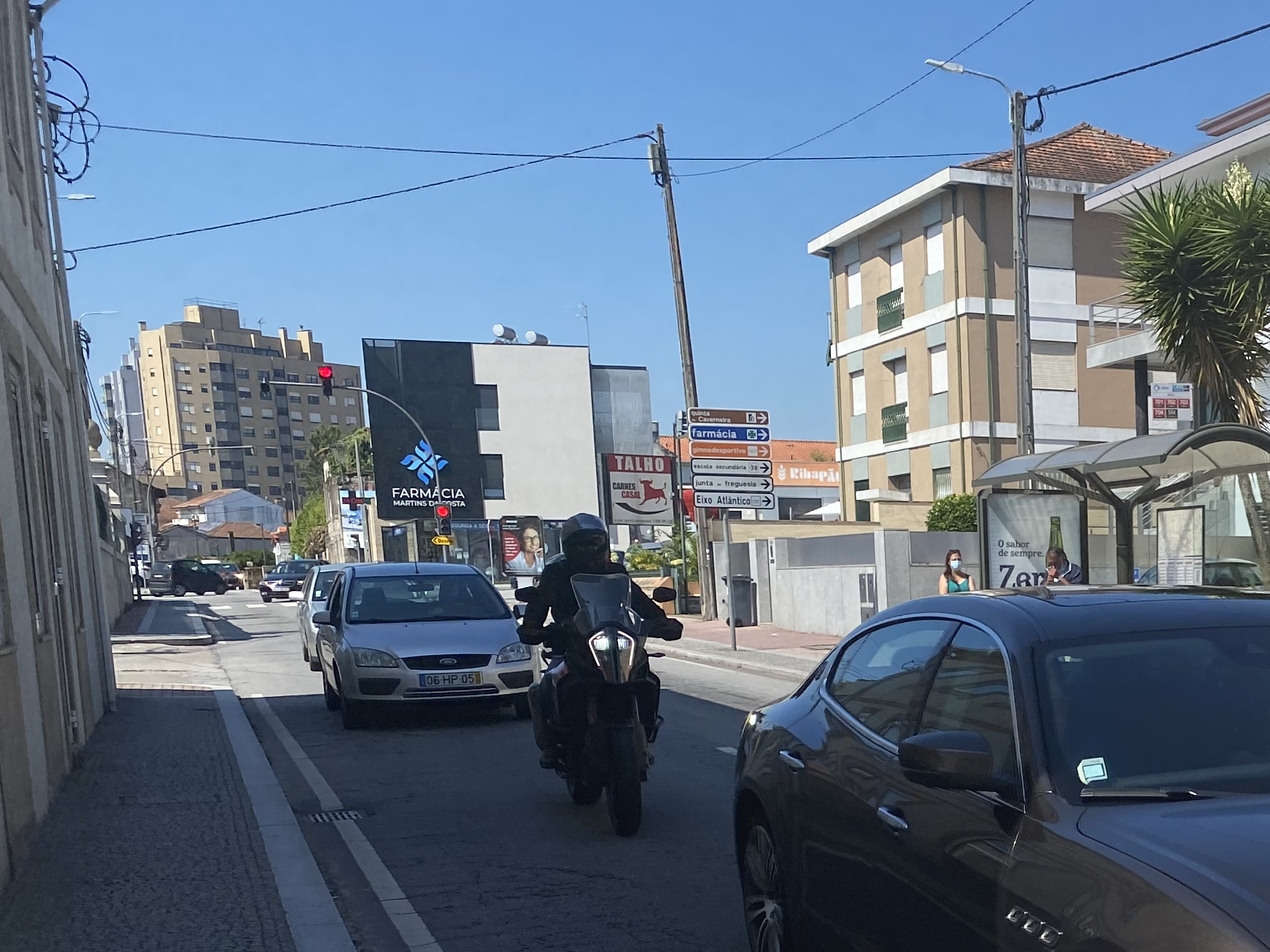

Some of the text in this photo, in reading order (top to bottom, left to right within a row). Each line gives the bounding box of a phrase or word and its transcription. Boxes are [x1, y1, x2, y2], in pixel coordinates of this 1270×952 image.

[692, 428, 737, 439] farmácia
[614, 455, 664, 472] TALHO
[612, 482, 636, 490] CARNES
[724, 480, 757, 488] freguesia
[391, 485, 465, 499] FARMÁCIA
[621, 491, 641, 499] CASAL
[696, 495, 751, 505] Eixo Atlântico
[997, 540, 1030, 548] O sabor
[998, 549, 1044, 559] de sempre.
